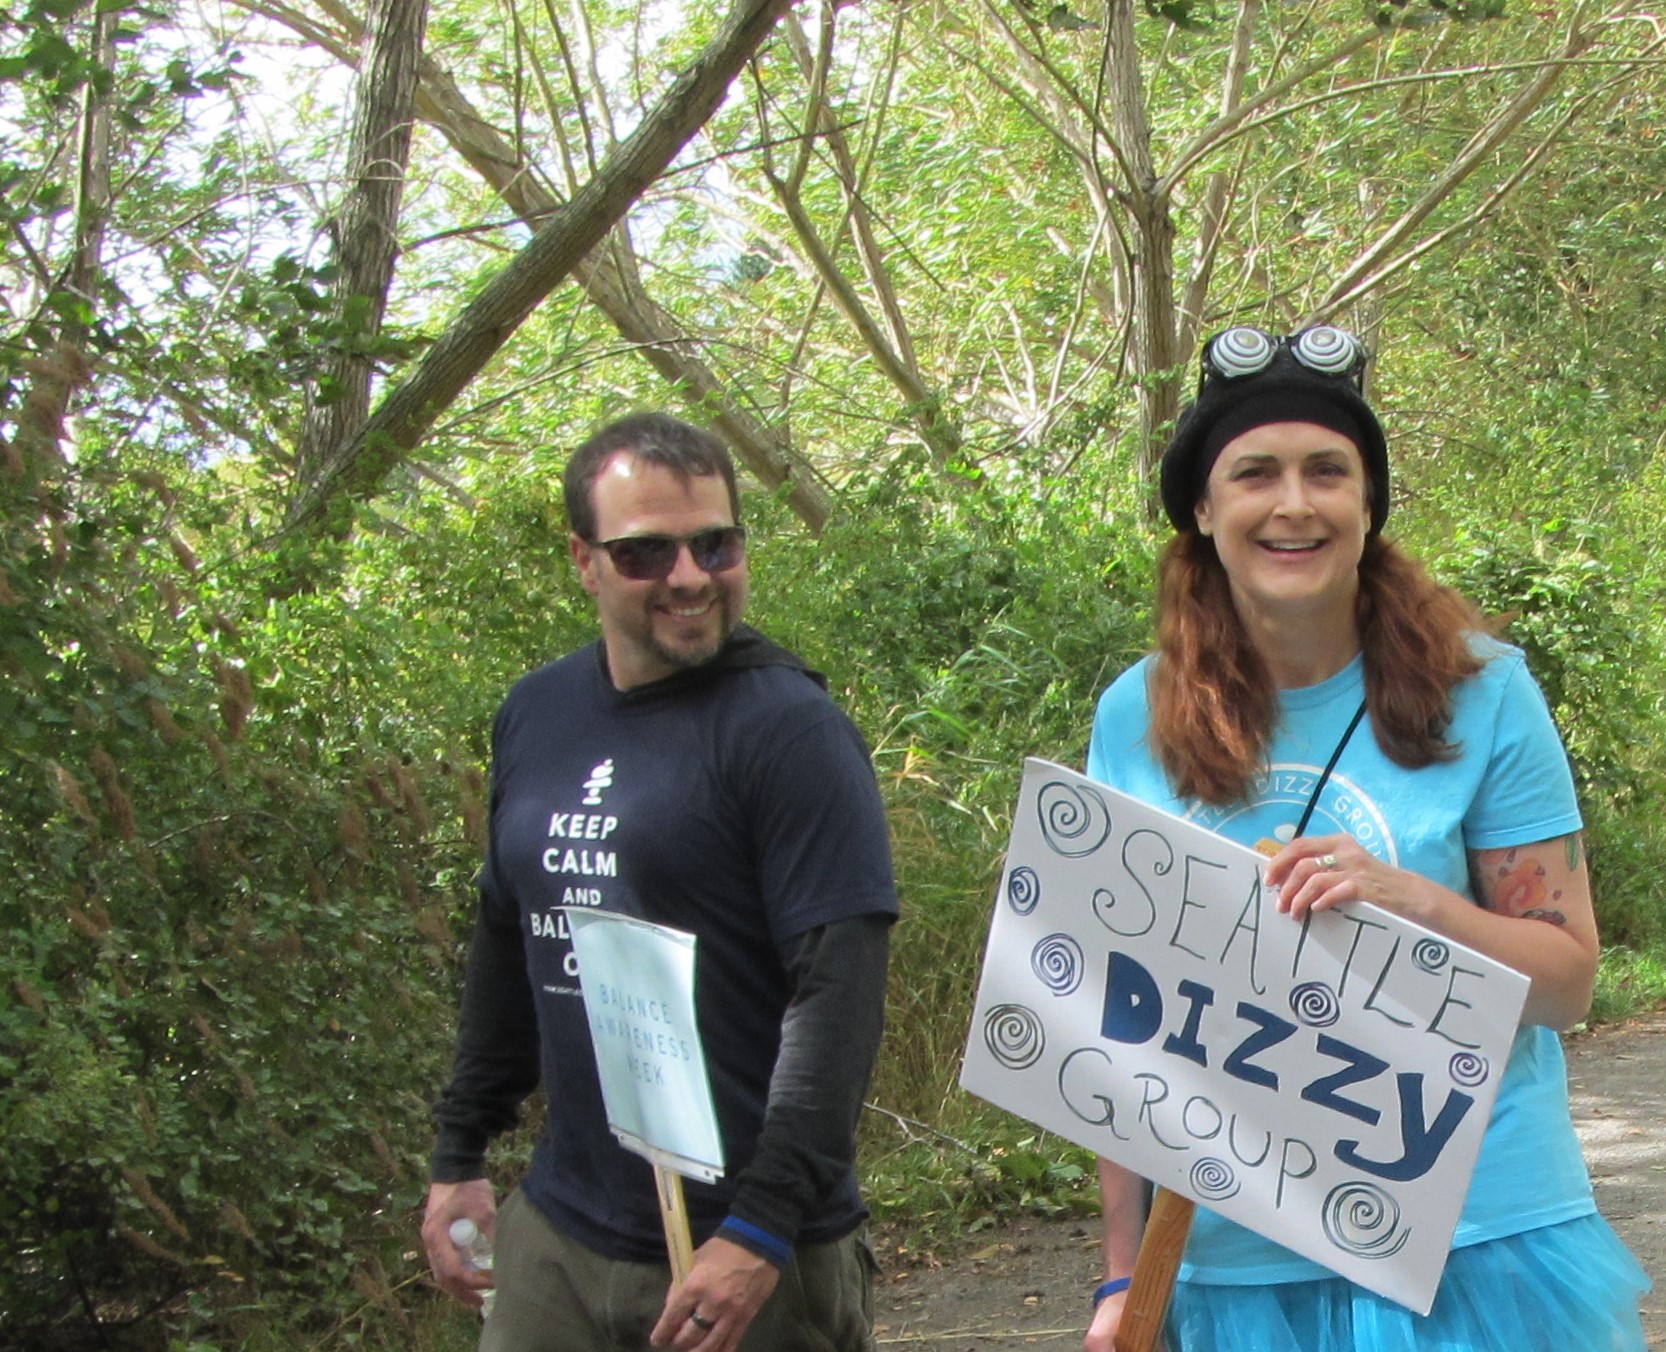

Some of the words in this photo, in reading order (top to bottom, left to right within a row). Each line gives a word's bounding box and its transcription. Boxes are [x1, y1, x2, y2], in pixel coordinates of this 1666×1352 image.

[548, 812, 618, 840] KEEP
[542, 847, 618, 877] CALM
[562, 886, 602, 906] AND
[599, 983, 671, 1025] BALANCE
[1058, 1047, 1317, 1209] GROUP
